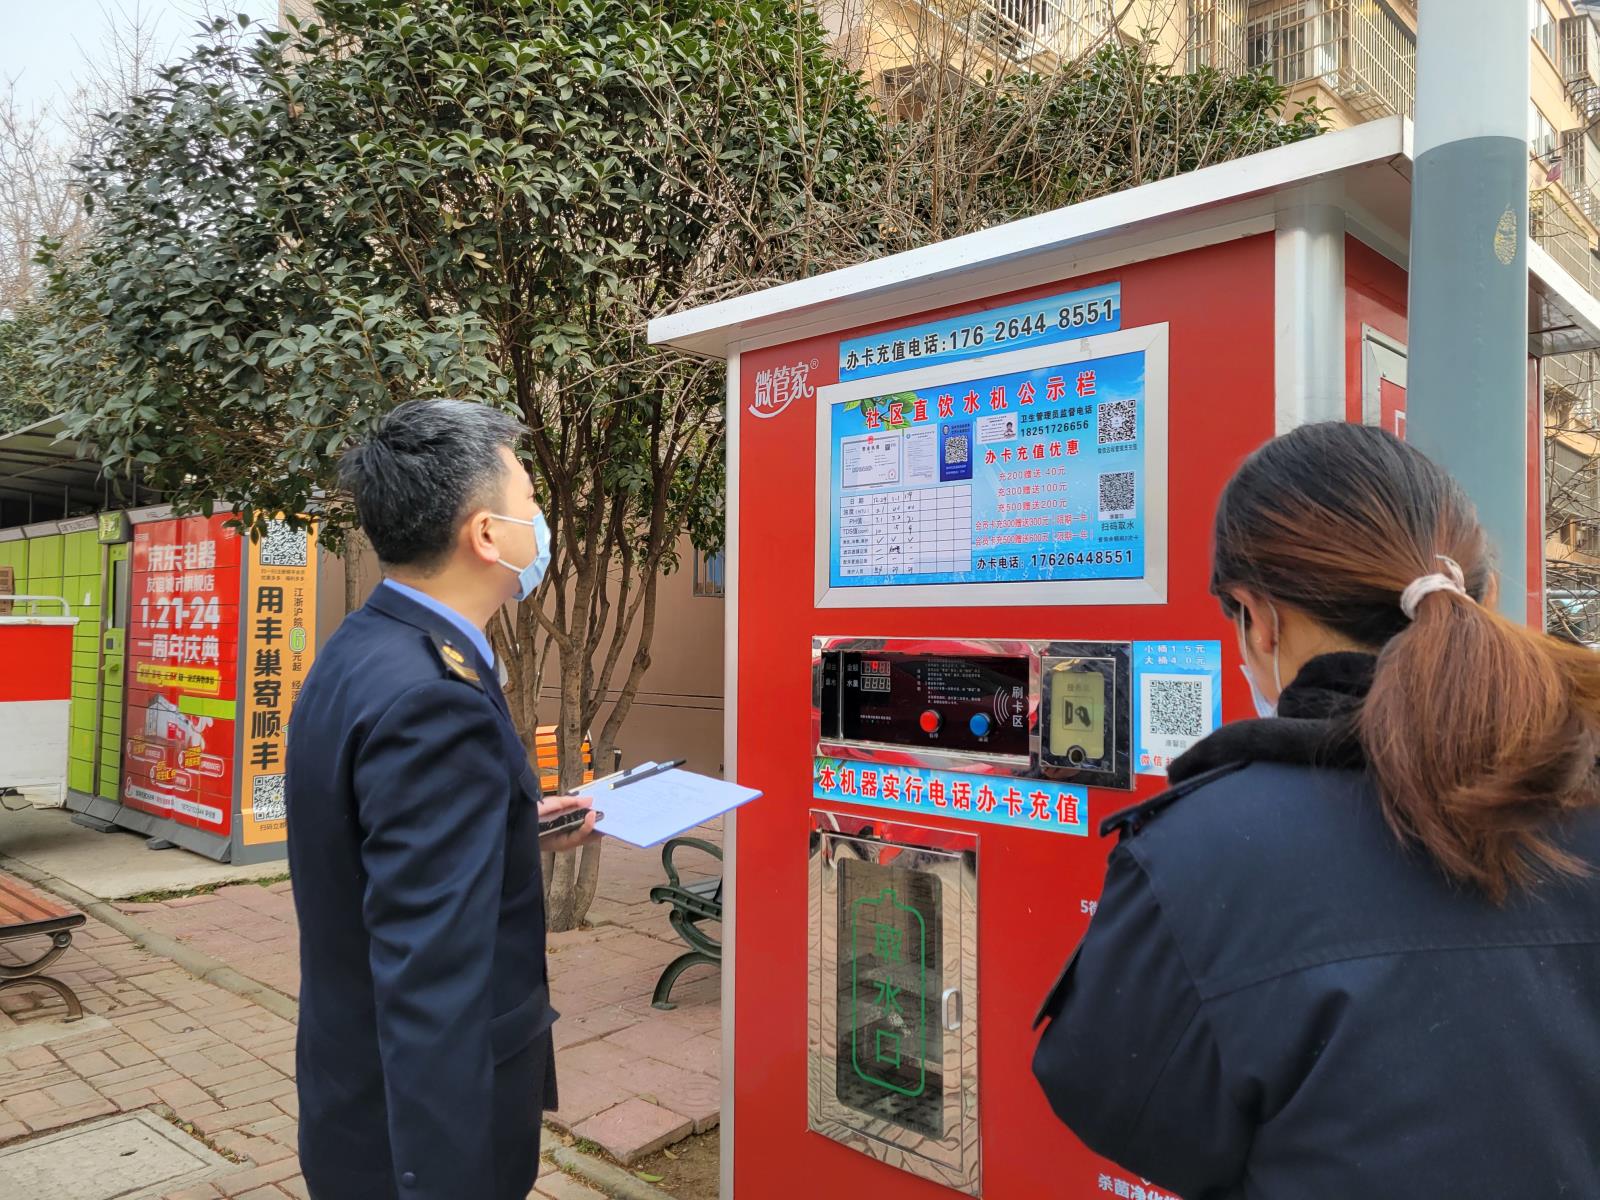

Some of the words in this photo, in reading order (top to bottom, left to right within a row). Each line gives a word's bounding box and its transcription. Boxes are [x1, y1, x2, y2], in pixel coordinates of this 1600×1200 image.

[994, 314, 1046, 343] 2644
[1058, 298, 1114, 329] 8551
[754, 361, 814, 408] 微管家
[866, 371, 1097, 429] 社区直饮水机公示栏
[1020, 405, 1093, 424] 卫生管理员监督电话
[1021, 420, 1089, 437] 18251726656
[985, 440, 1080, 464] 办卡充值优惠
[997, 483, 1068, 497] 充300赠送100元
[997, 499, 1068, 513] 充500赠送200元
[1031, 550, 1133, 567] 17626448551
[140, 596, 220, 629] 1.21-24
[138, 634, 219, 666] 一周年庆典
[250, 586, 283, 770] 用丰巢寄顺丰
[1012, 686, 1024, 728] 刷卡区
[819, 765, 1080, 825] 本机器实行电话办卡充值
[873, 923, 904, 1070] 取水口
